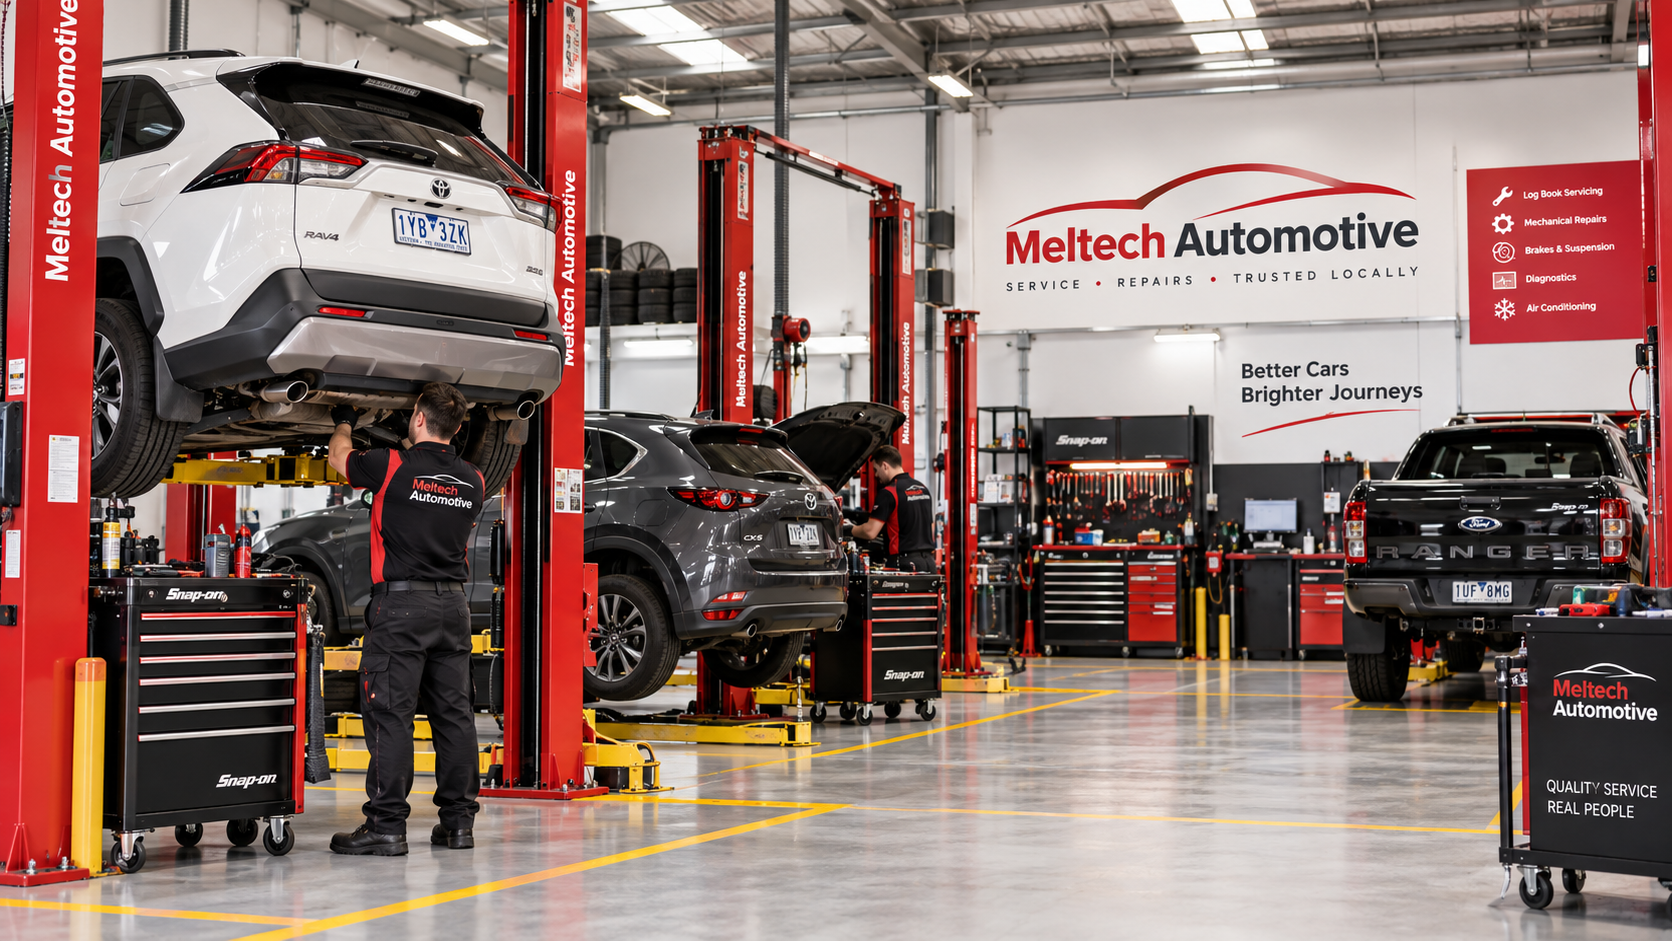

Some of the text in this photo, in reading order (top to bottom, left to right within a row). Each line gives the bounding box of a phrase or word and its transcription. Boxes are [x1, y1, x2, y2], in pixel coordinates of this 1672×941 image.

[45, 0, 78, 282] Meltech Automotive
[1523, 187, 1603, 200] Log Book Servicing
[1524, 215, 1607, 226] Mechanical Repairs
[303, 230, 339, 242] RAV4
[1006, 212, 1419, 265] Meltech Automotive
[1525, 242, 1615, 255] Brakes & Suspension
[561, 170, 576, 366] Meltech Automotive
[1006, 266, 1418, 291] SERVICE REPAIRS TRUSTED LOCALLY
[1526, 273, 1577, 284] Diagnostics
[736, 271, 747, 351] Automotive
[1526, 302, 1596, 313] Air Conditioning
[1241, 361, 1349, 379] Better Cars
[1241, 384, 1423, 407] Brighter Journeys
[1055, 435, 1108, 447] Snap-on
[412, 478, 458, 496] Meltech
[409, 490, 473, 509] Automotive
[1376, 545, 1589, 559] RANGER
[165, 588, 223, 602] Snap-on
[1456, 584, 1510, 598] 1UF 8MG
[884, 669, 925, 682] Snap-on
[1553, 679, 1628, 700] Meltech
[1552, 700, 1658, 721] Automotive
[215, 774, 277, 789] Snap-on
[1546, 779, 1658, 799] QUALITY SERVICE
[1547, 800, 1635, 819] REAL PEOPLE
